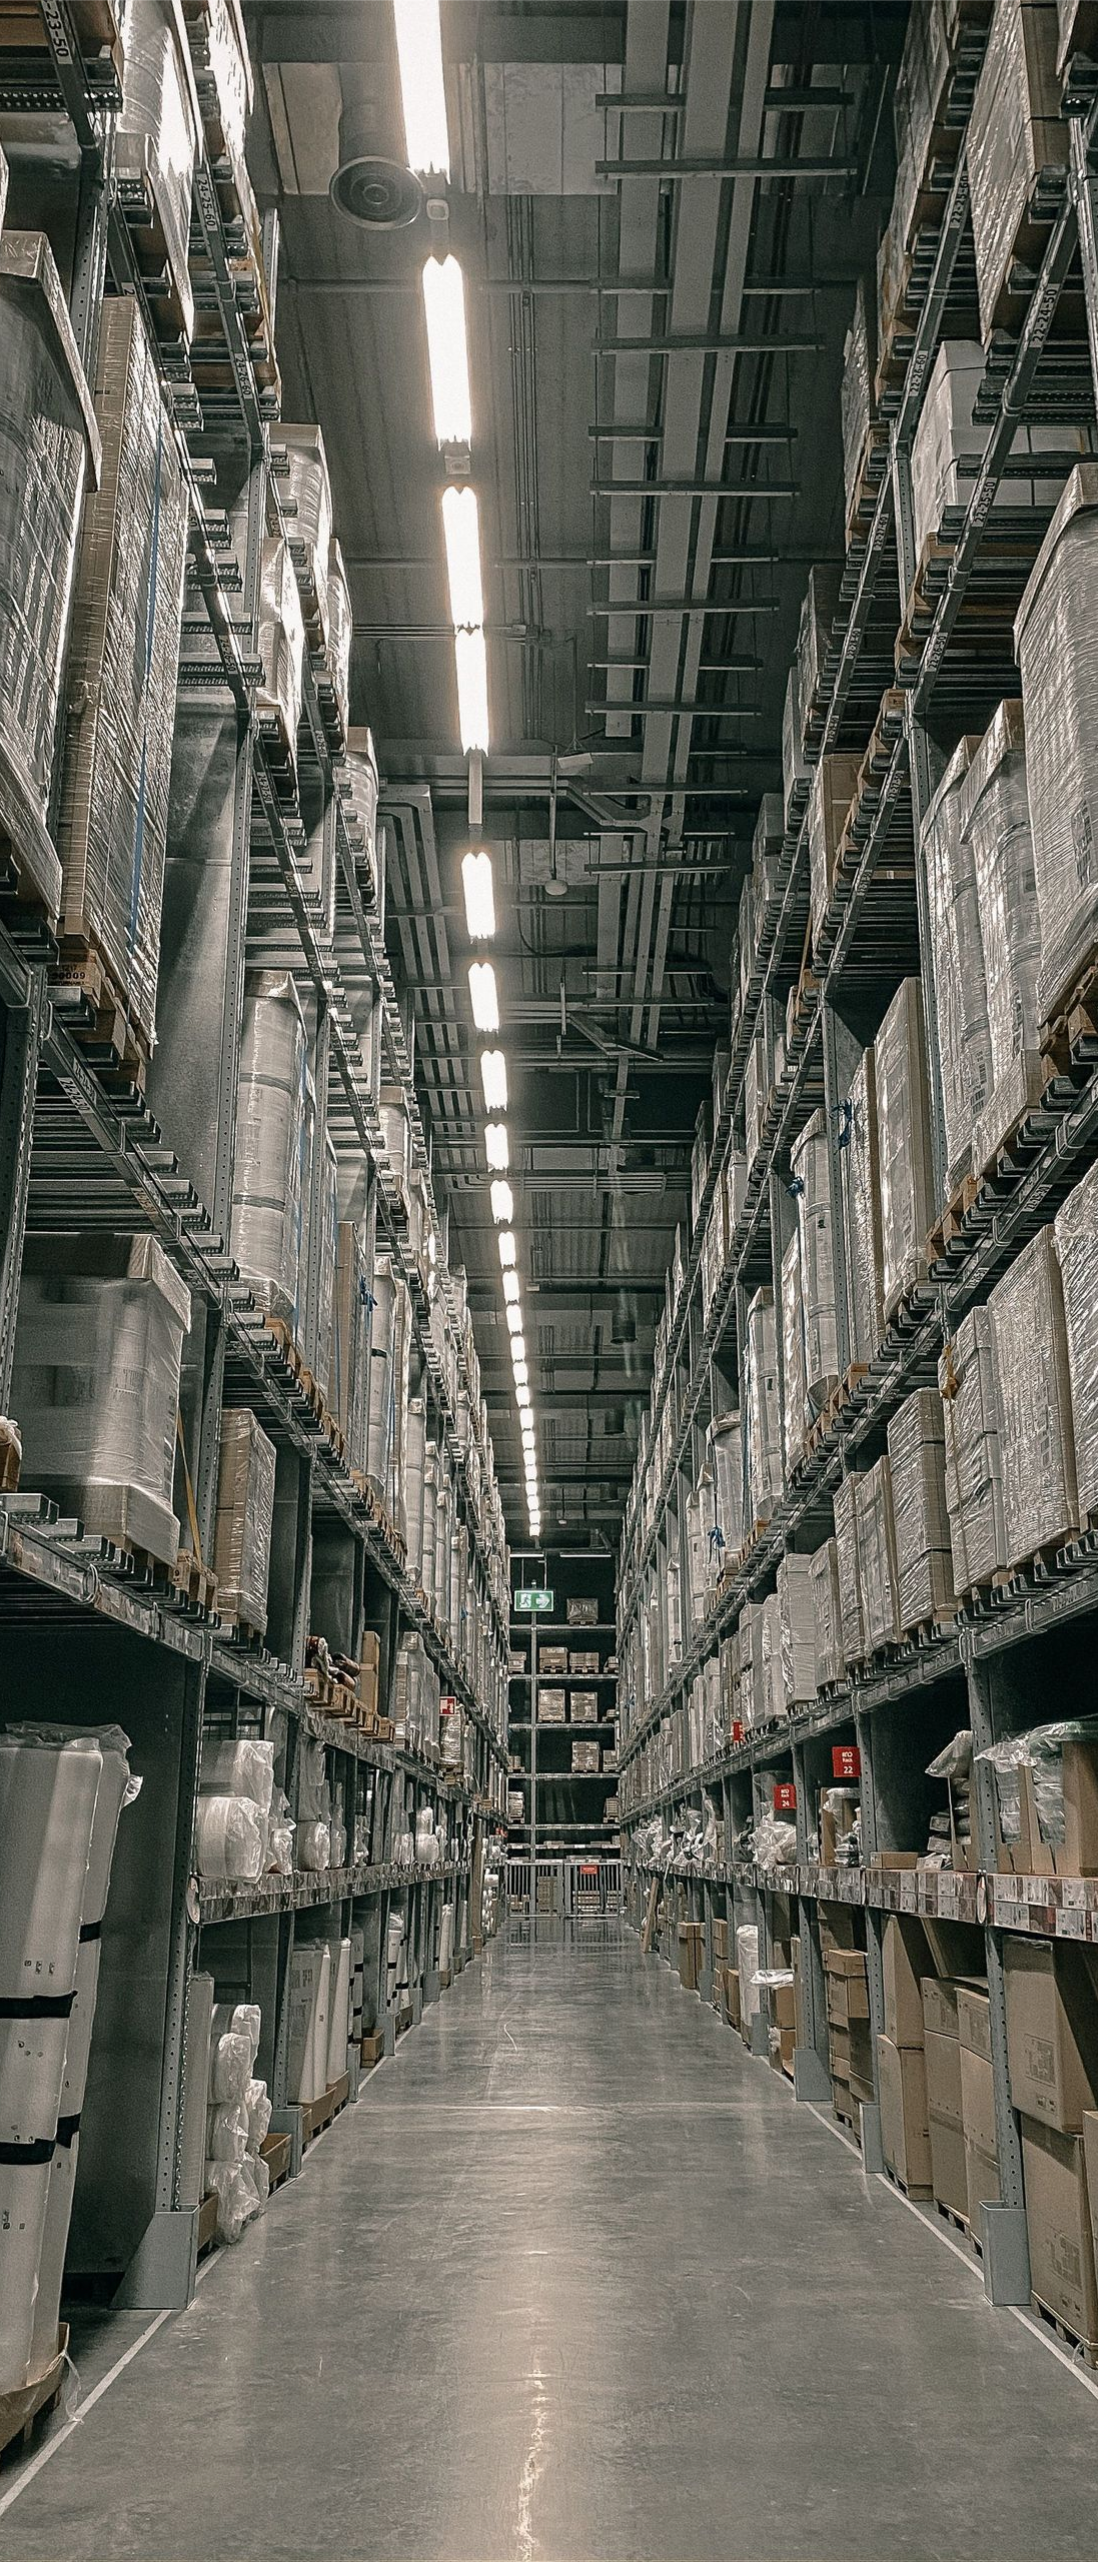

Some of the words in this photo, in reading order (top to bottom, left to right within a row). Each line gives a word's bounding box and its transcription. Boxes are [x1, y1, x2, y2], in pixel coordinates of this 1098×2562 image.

[42, 0, 69, 57] -23-50
[200, 179, 216, 227] 24-25-60
[951, 175, 969, 223] 22-25-60
[1033, 289, 1057, 342] 22-24-50
[236, 356, 251, 396] 24-26-60
[911, 354, 927, 392] 22-26-60
[974, 481, 995, 522] 22-25-50
[928, 634, 946, 669] 22-26-50
[843, 1766, 853, 1774] 22
